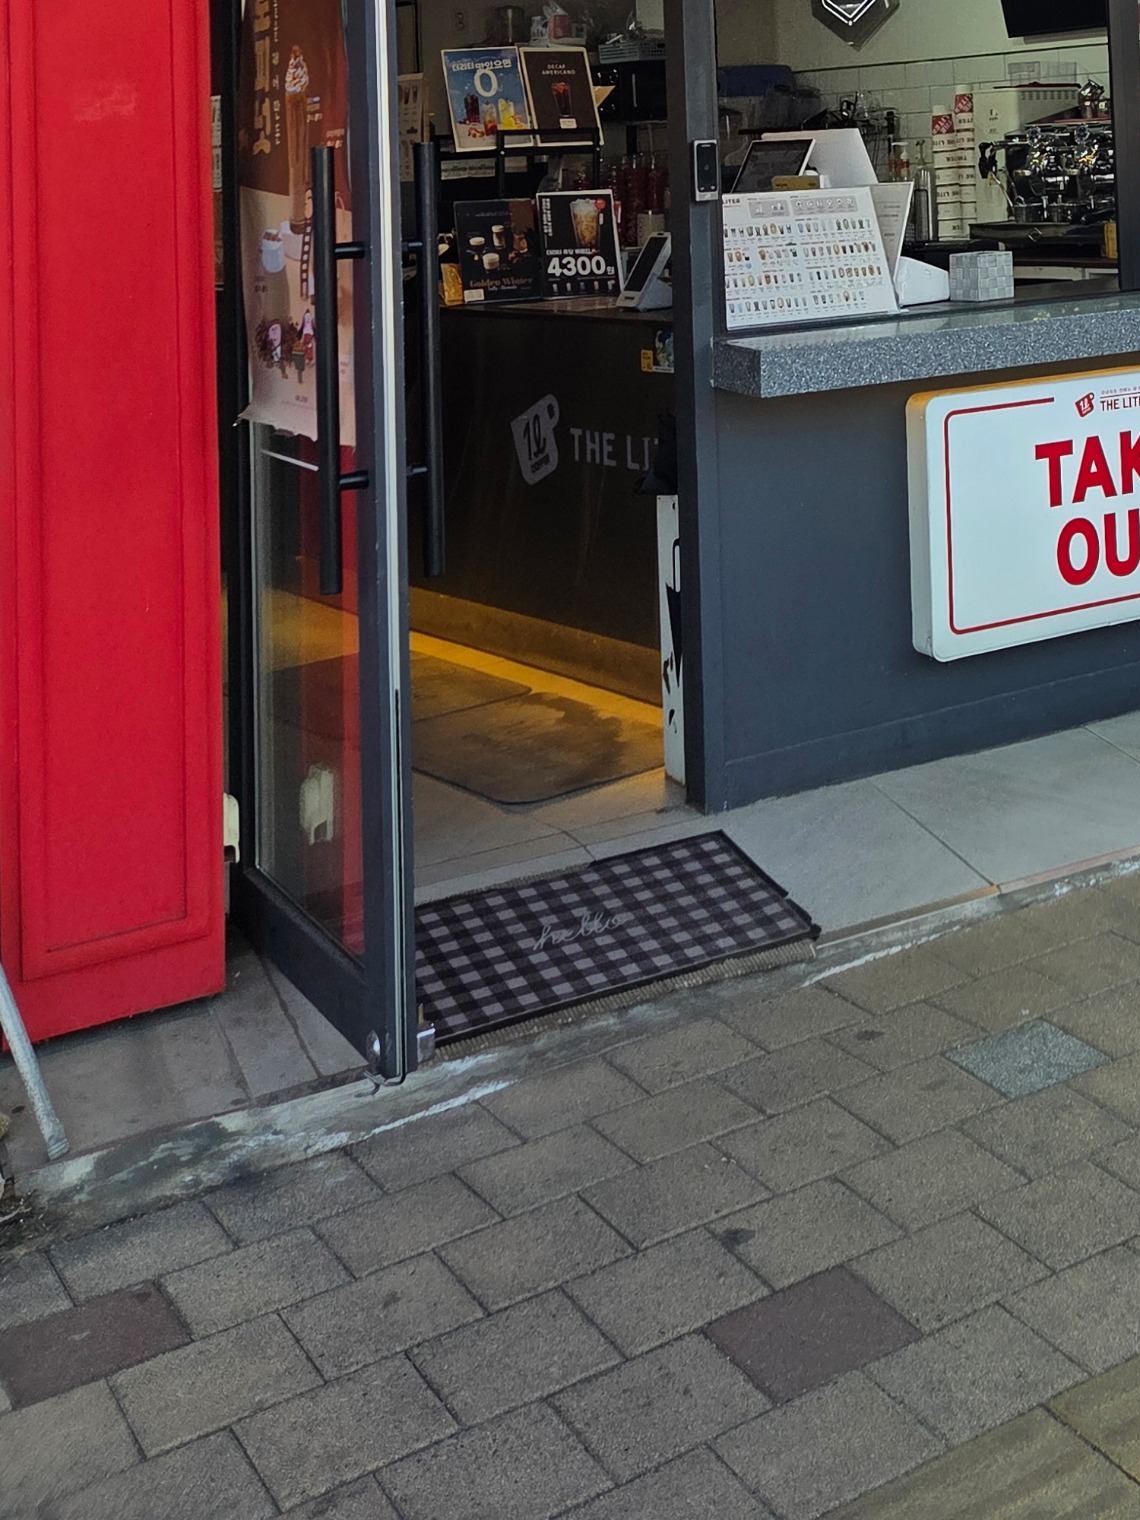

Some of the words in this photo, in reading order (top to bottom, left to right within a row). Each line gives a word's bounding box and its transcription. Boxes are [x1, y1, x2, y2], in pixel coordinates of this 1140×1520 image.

[547, 255, 606, 277] 4300
[1100, 398, 1120, 411] THE
[570, 427, 617, 467] THE
